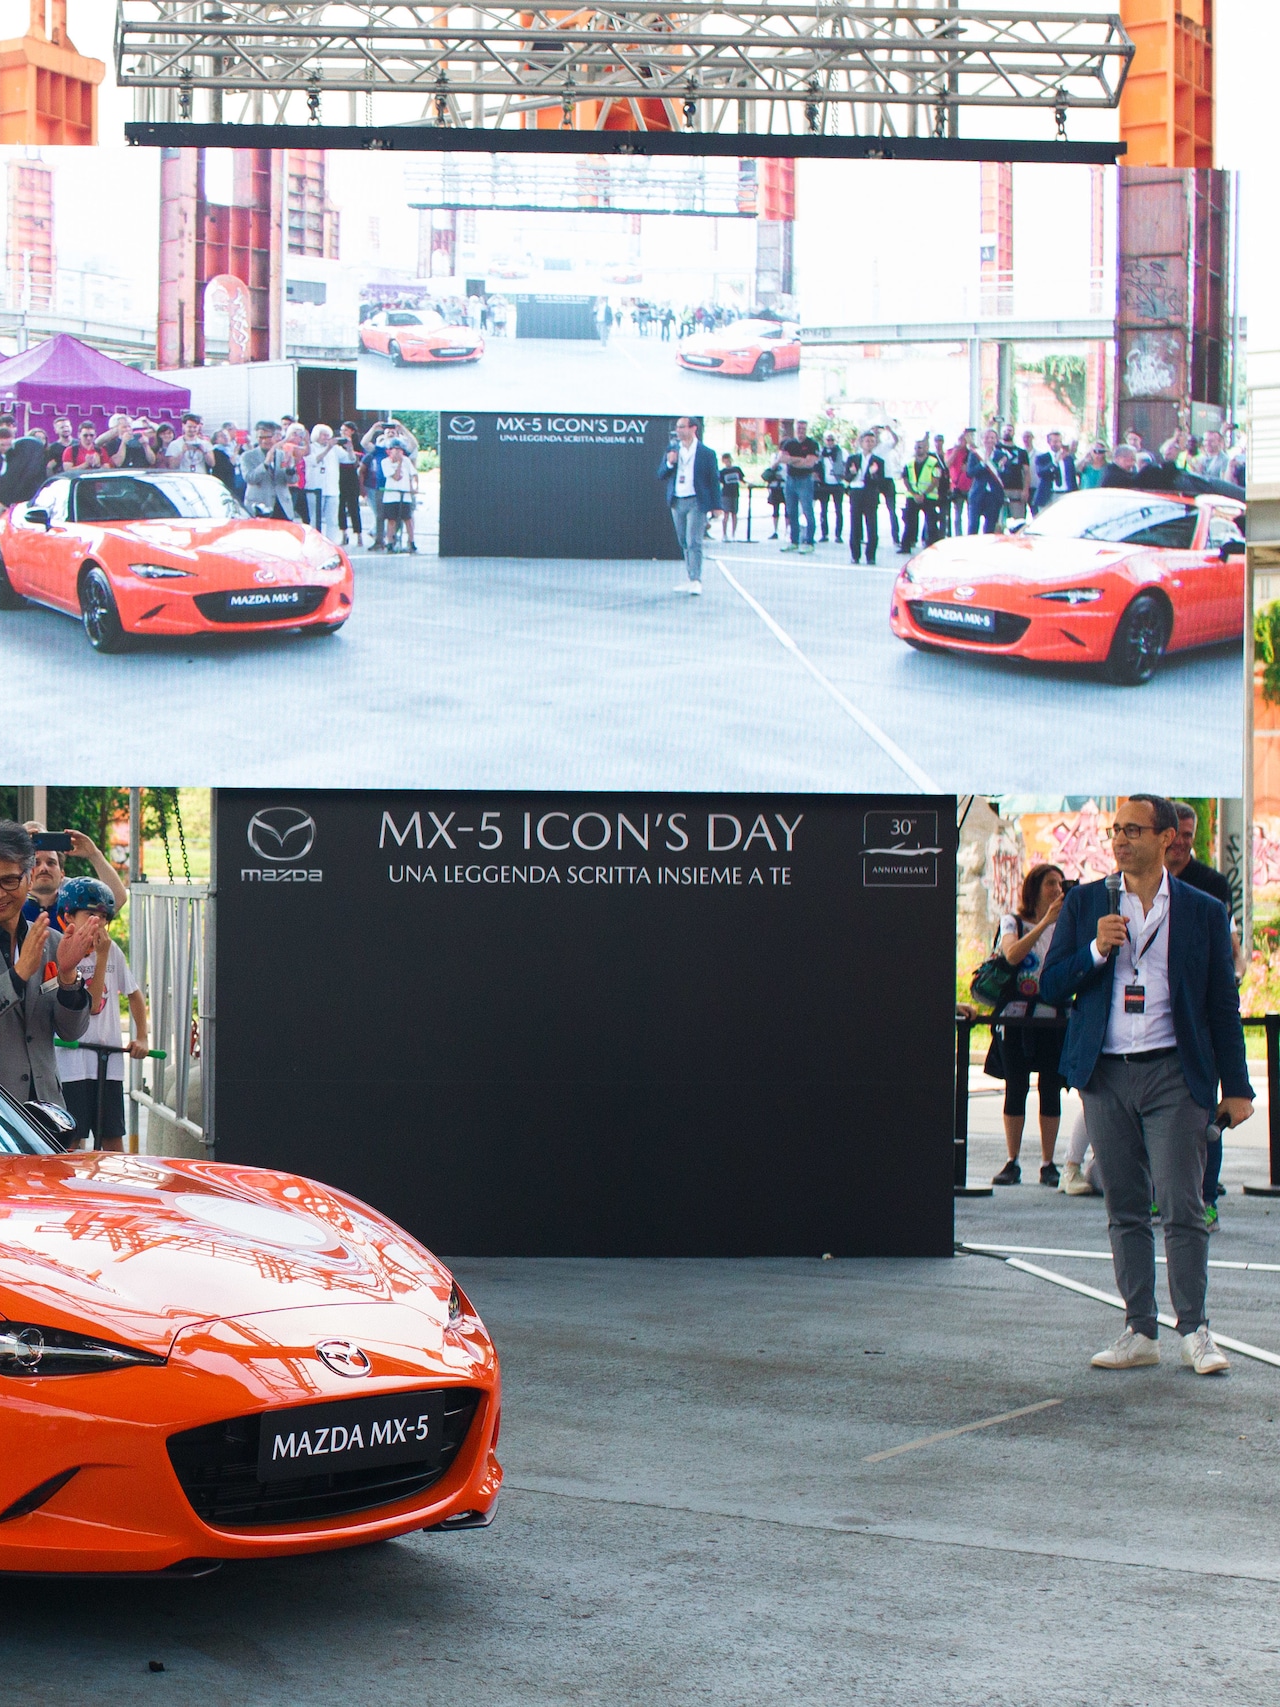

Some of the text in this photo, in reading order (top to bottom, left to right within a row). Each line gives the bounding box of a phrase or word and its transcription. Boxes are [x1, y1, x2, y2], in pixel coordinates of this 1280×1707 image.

[496, 417, 649, 434] MX-5 ICON'S DAY
[500, 434, 518, 442] UNA
[230, 593, 298, 606] MAZDA MX-5
[927, 607, 964, 622] MAZDA
[378, 811, 804, 851] MX-5 ICON'S DAY
[241, 869, 323, 882] mazda
[389, 865, 792, 886] UNA LEGGENDA SCRITTA INSIEME A TE
[872, 866, 929, 874] ANNIVERSARY
[272, 1414, 429, 1461] MAZDA MX-5
